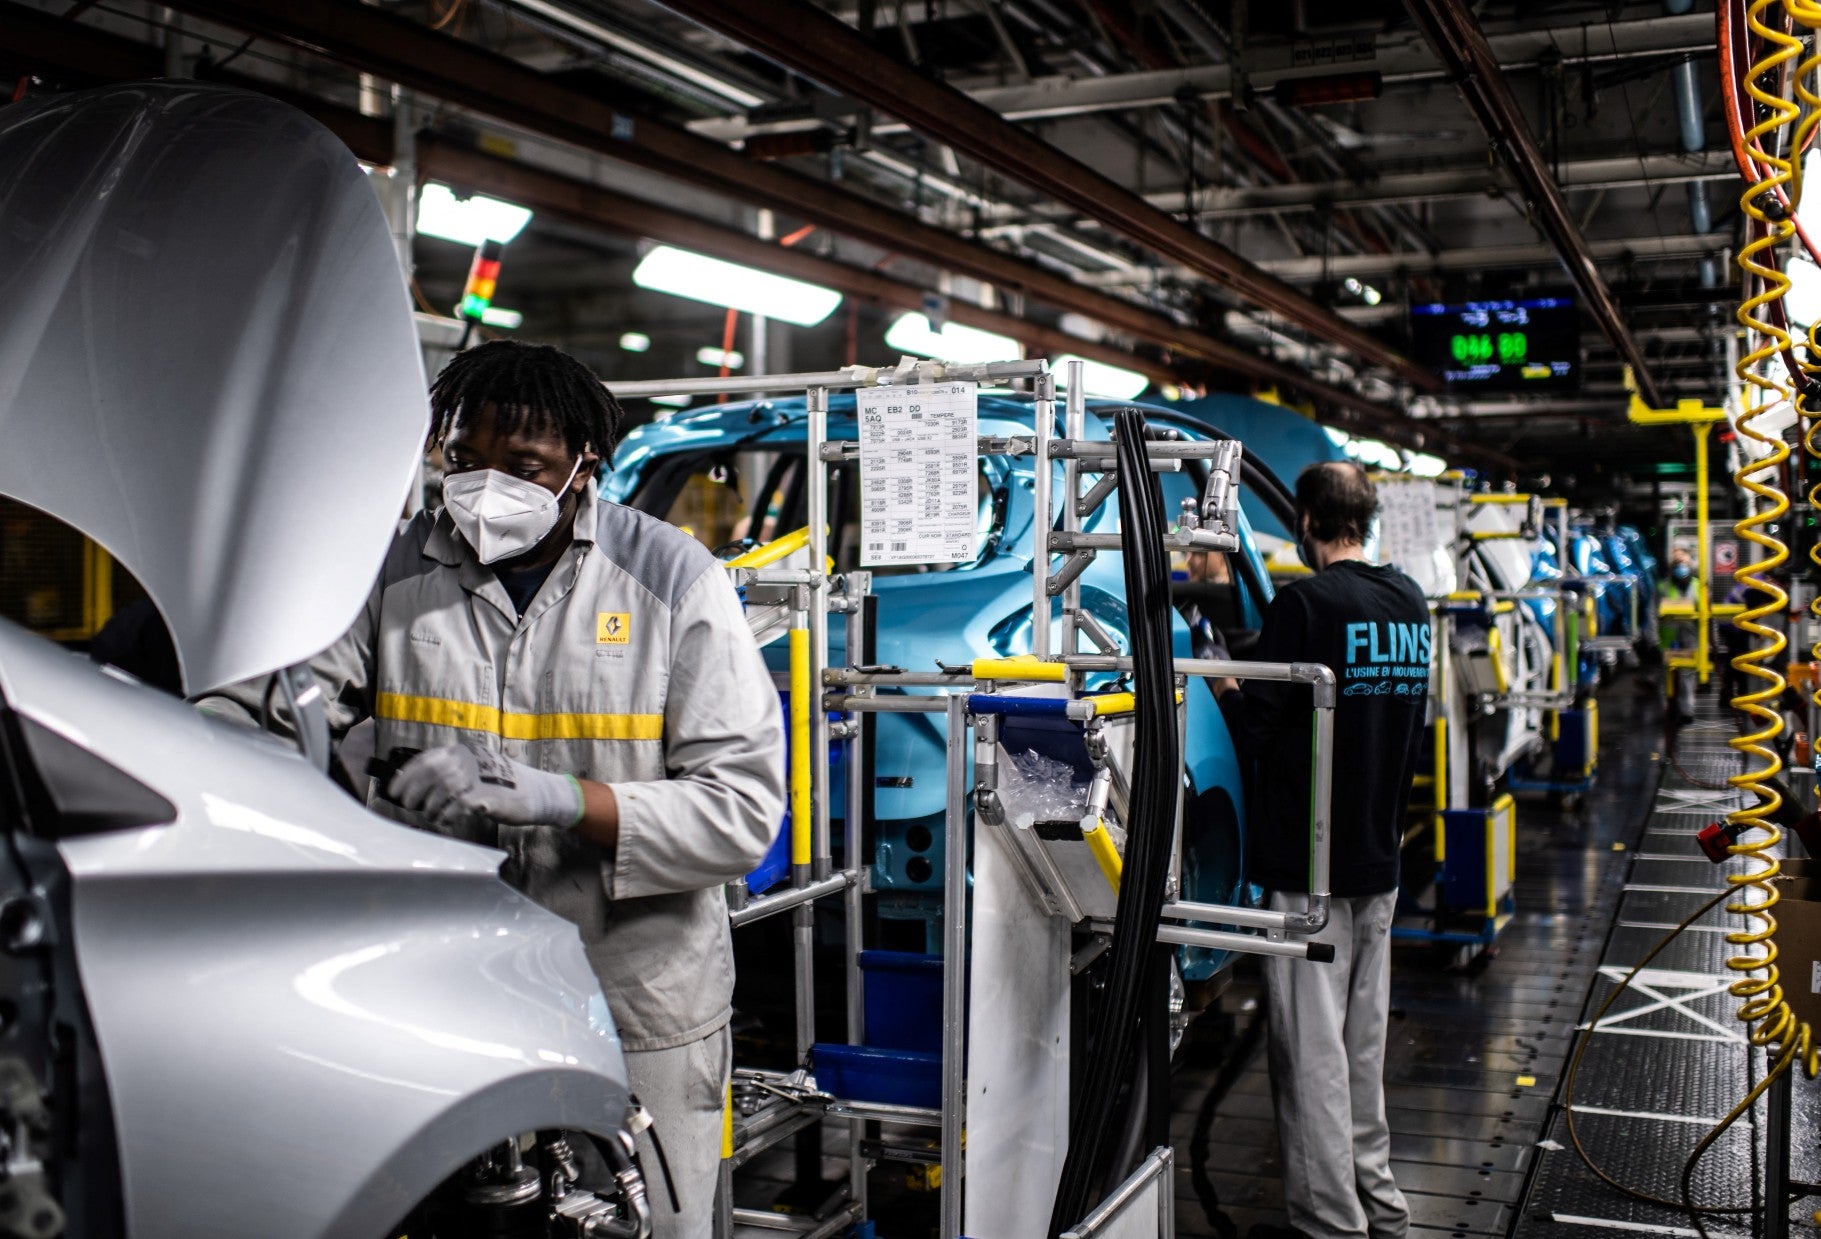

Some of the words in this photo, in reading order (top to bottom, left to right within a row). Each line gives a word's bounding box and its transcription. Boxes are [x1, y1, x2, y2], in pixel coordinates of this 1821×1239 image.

[865, 415, 882, 423] 5AQ
[1346, 621, 1431, 664] FLINS
[1346, 666, 1381, 678] L'USINE
